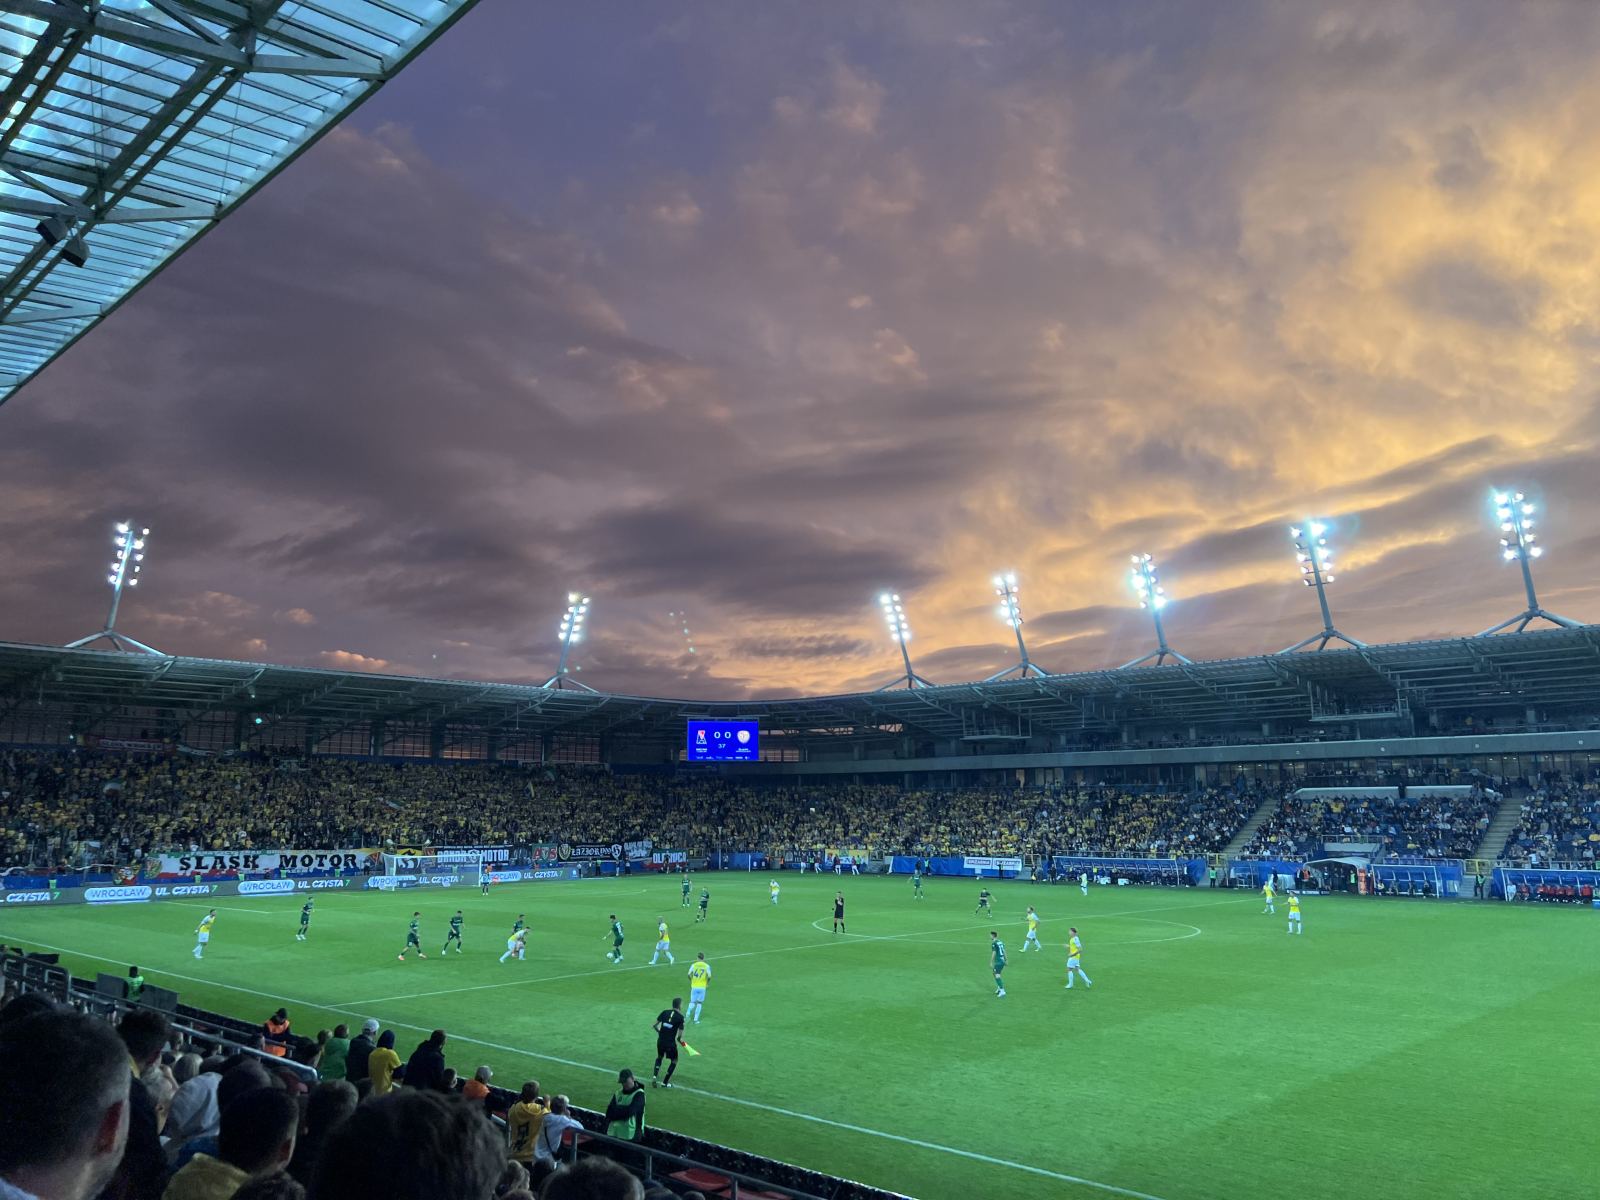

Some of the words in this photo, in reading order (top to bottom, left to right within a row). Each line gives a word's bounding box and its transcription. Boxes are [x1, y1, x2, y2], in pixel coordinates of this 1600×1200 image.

[279, 853, 357, 869] MOTOR
[534, 870, 558, 878] CZYSTA
[243, 881, 292, 891] WROCŁAW
[312, 879, 343, 889] CZYSTA
[91, 888, 147, 898] WROCŁAW
[172, 885, 210, 895] CZYSTA
[211, 884, 218, 893] 7
[6, 892, 50, 902] CZYSTA
[694, 968, 705, 978] 47
